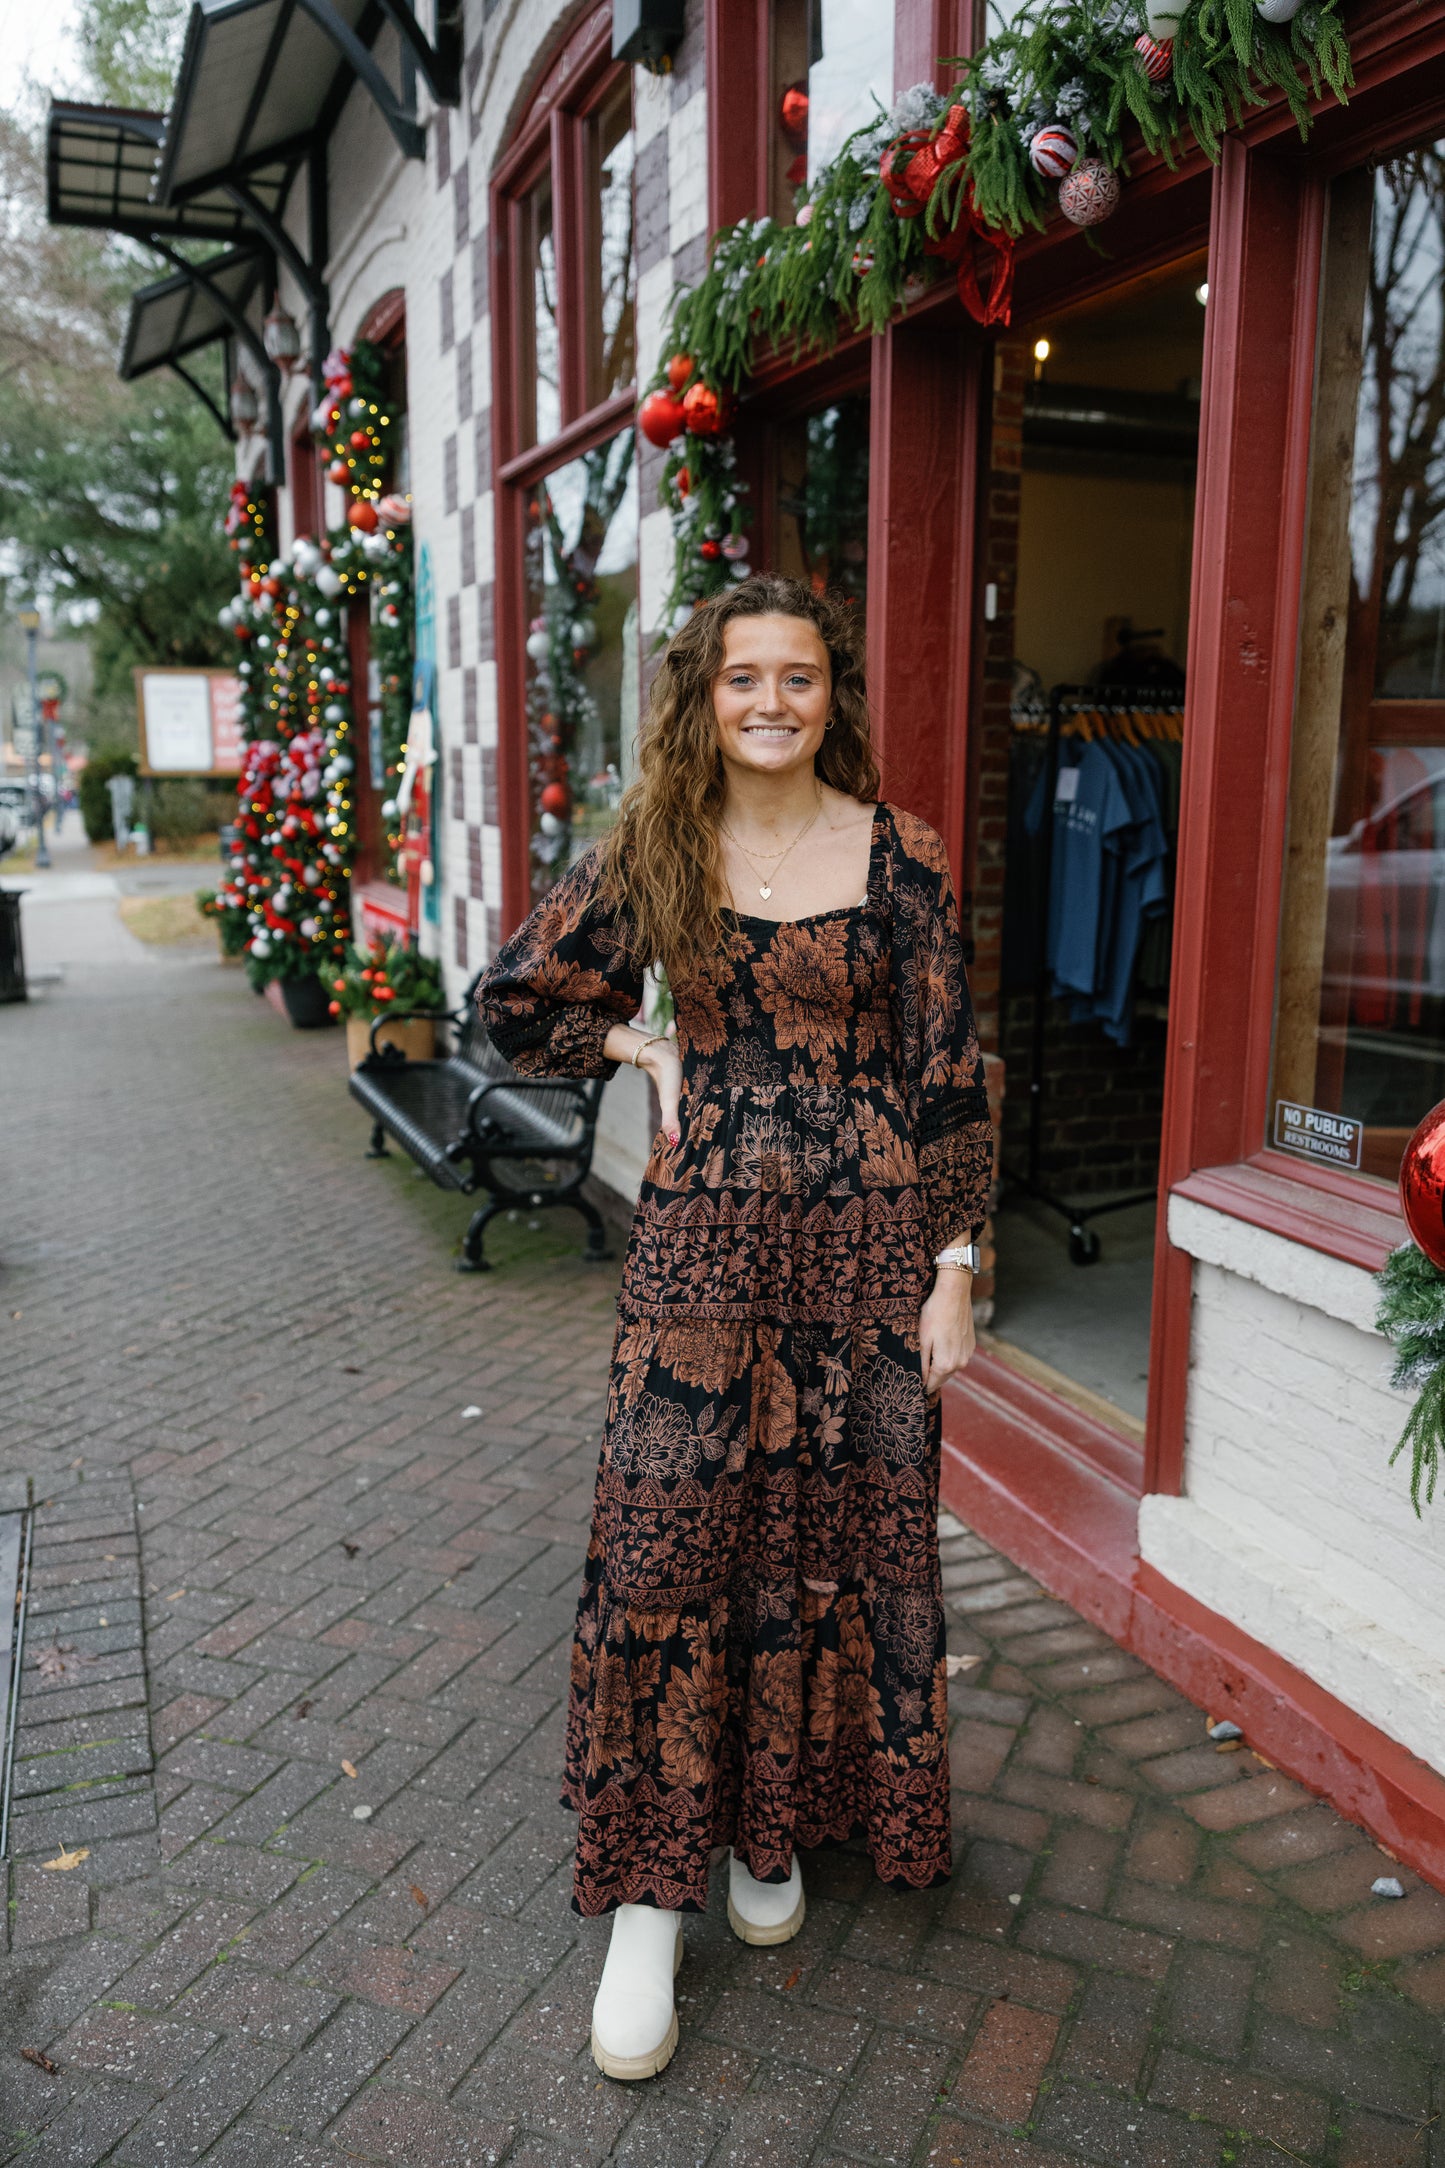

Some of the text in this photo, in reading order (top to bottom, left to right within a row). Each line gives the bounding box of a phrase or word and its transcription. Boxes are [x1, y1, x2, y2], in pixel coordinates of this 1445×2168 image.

[1283, 1107, 1354, 1140] NO PUBLIC
[1284, 1130, 1351, 1160] RESTROOMS
